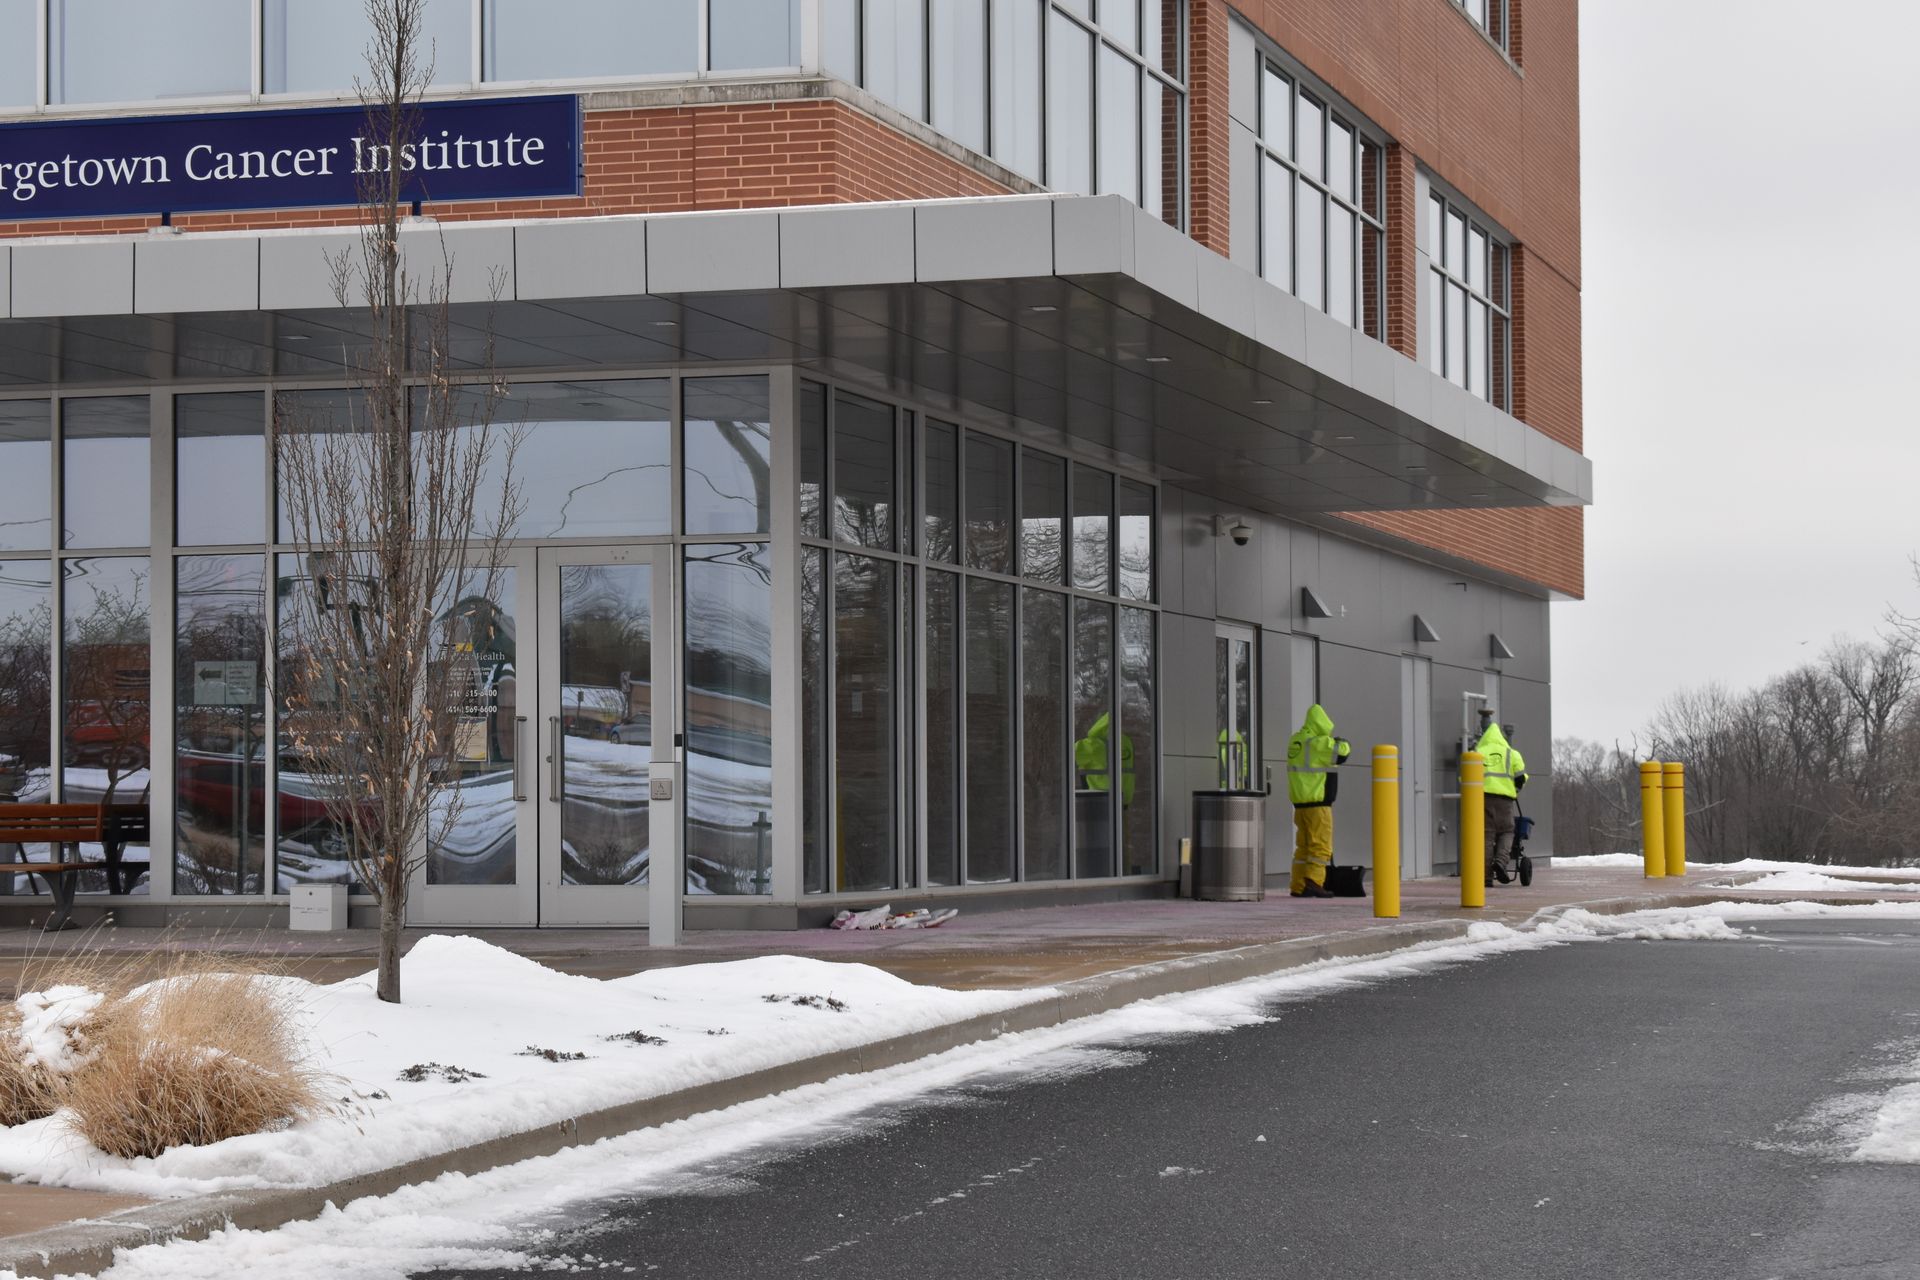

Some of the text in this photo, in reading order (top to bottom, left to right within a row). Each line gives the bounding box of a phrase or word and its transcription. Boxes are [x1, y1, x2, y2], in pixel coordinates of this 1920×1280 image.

[0, 130, 545, 201] rgetown Cancer Institute
